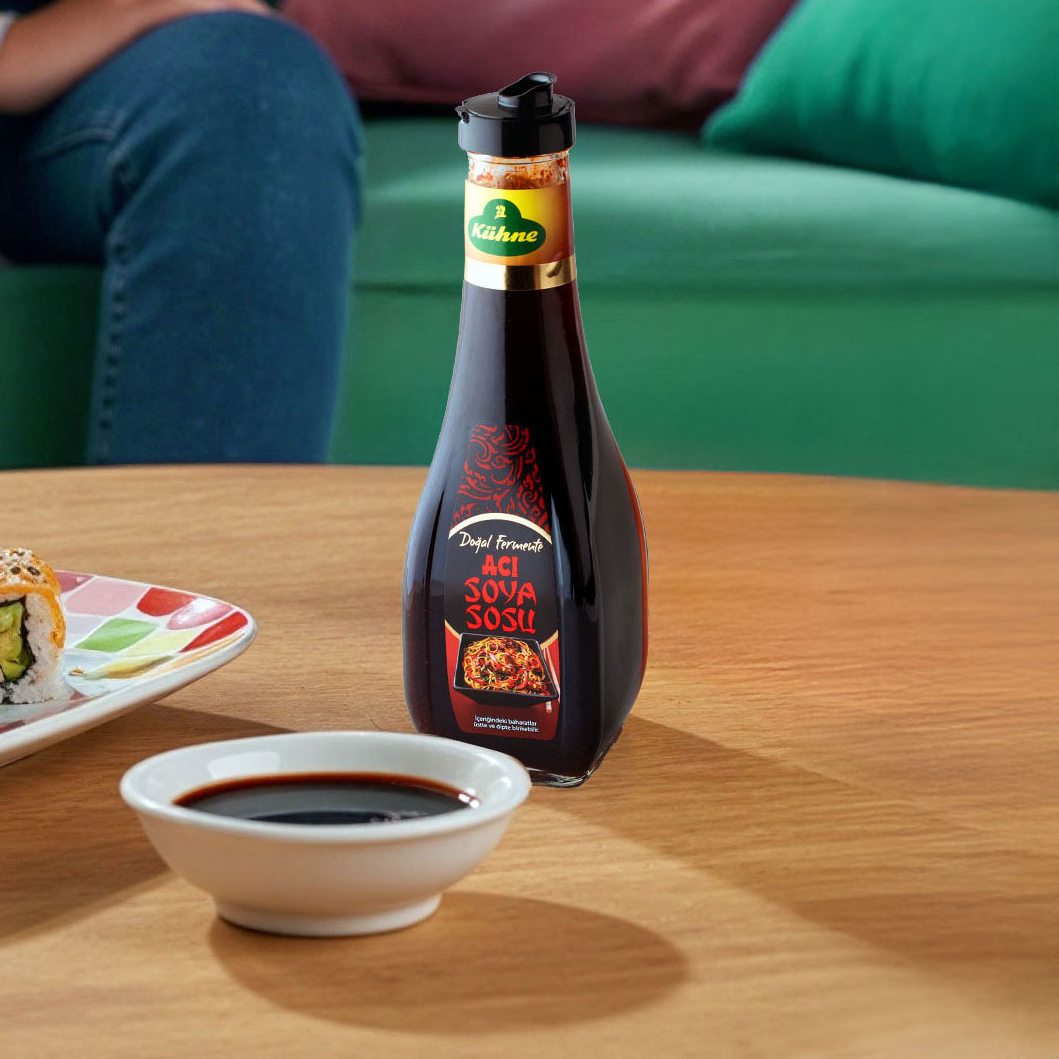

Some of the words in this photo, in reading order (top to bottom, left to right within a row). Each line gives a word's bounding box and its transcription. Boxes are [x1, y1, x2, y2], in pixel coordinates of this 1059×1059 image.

[471, 222, 539, 243] Kühne
[459, 531, 493, 554] Doğal
[496, 534, 544, 553] Fermente
[481, 554, 518, 578] ACI
[464, 576, 537, 607] SOYA
[466, 604, 537, 635] SOSU
